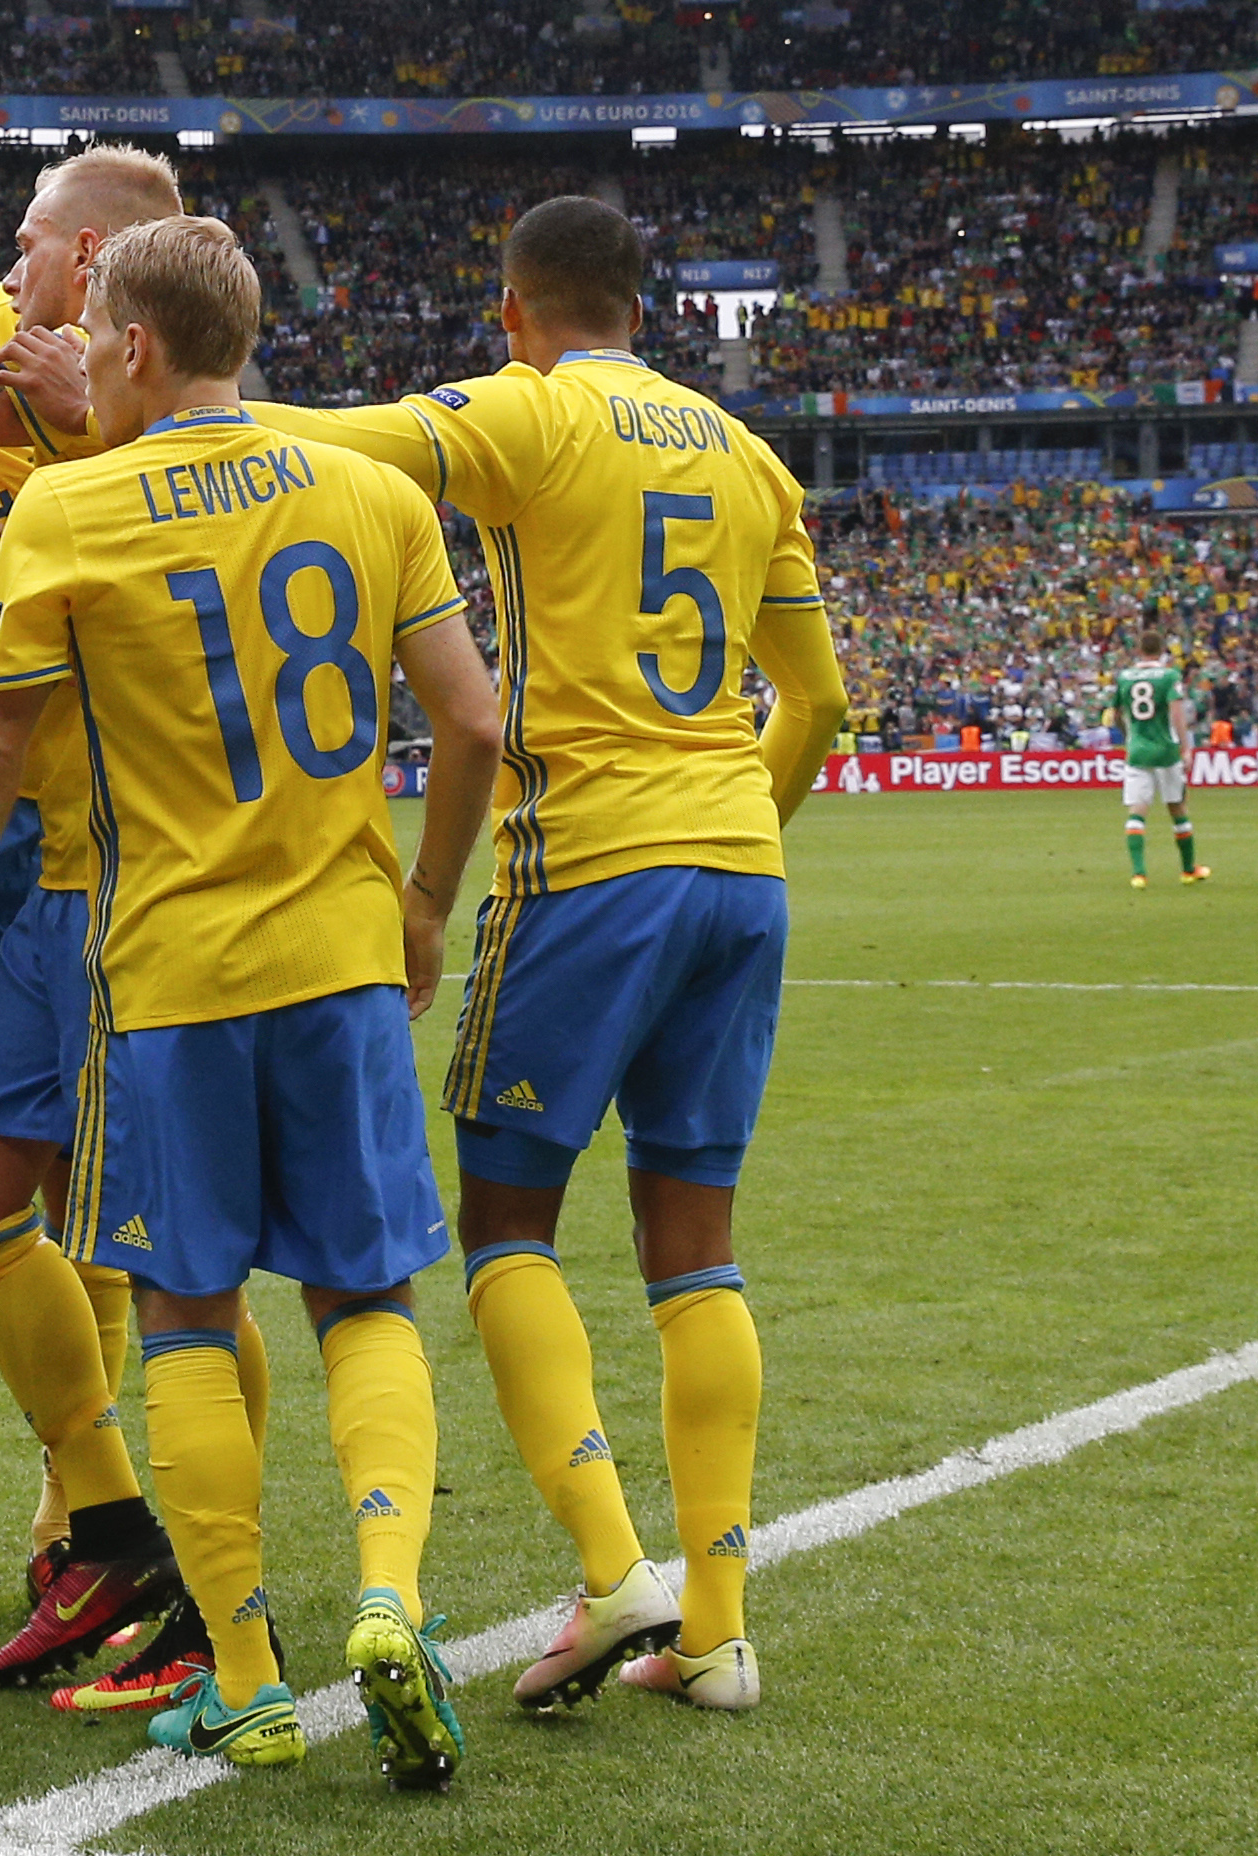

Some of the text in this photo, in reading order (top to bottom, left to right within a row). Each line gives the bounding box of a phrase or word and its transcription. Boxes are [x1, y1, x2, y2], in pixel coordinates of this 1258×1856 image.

[1065, 85, 1181, 105] SAINT-DENIS
[60, 106, 170, 123] SAINT-DENIS
[541, 104, 701, 122] UEFA EURO 2016
[909, 397, 1017, 414] SAINT-DENIS
[609, 395, 730, 454] OLSSON
[138, 445, 316, 523] LEWICKI
[636, 490, 727, 717] 5
[166, 540, 378, 804] 18
[1130, 681, 1156, 720] 8
[891, 755, 992, 790] Player
[1000, 753, 1127, 784] Escorts
[497, 1094, 545, 1113] adidas
[112, 1231, 153, 1251] adidas
